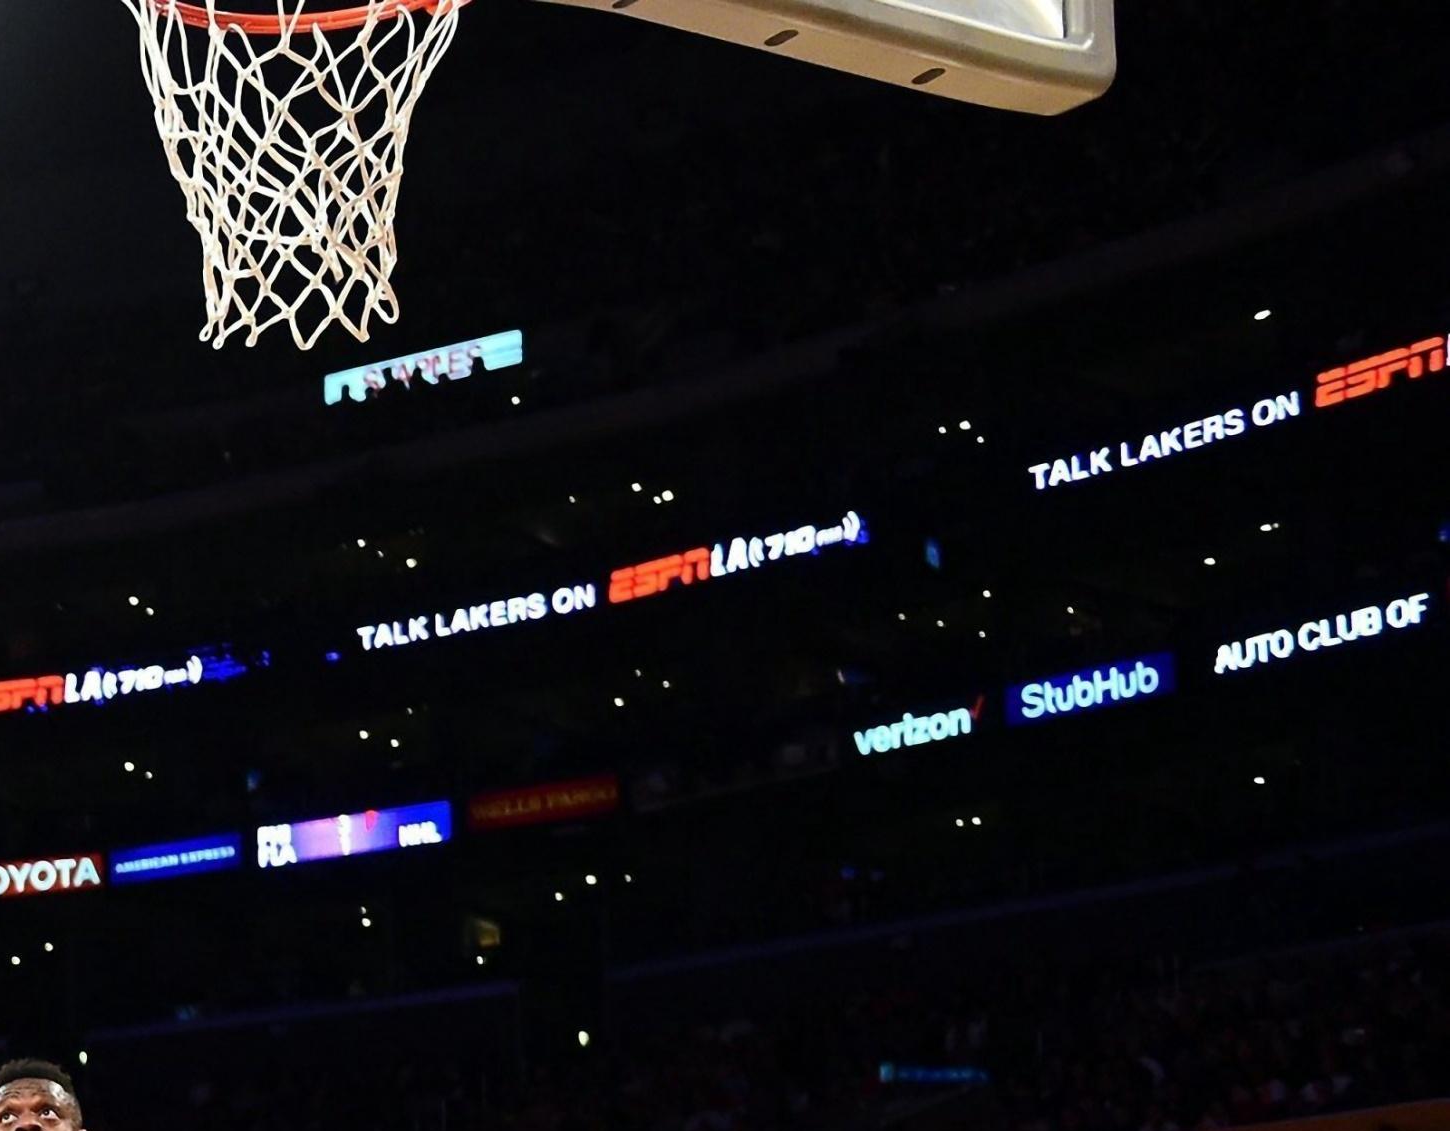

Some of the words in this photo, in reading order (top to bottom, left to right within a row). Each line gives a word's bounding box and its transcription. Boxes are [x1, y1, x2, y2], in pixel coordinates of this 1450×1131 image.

[1028, 447, 1113, 490] TALK
[1120, 408, 1246, 467] LAKERS
[1252, 391, 1300, 426] ON
[1315, 336, 1443, 408] ESPN
[356, 611, 429, 651] TALK
[435, 593, 548, 637] LAKERS
[552, 584, 596, 614] ON
[1213, 629, 1294, 675] AUTO
[1298, 606, 1383, 651] CLUB
[1386, 593, 1430, 629] OF
[1021, 661, 1159, 719] StubHub
[854, 705, 971, 756] verizon
